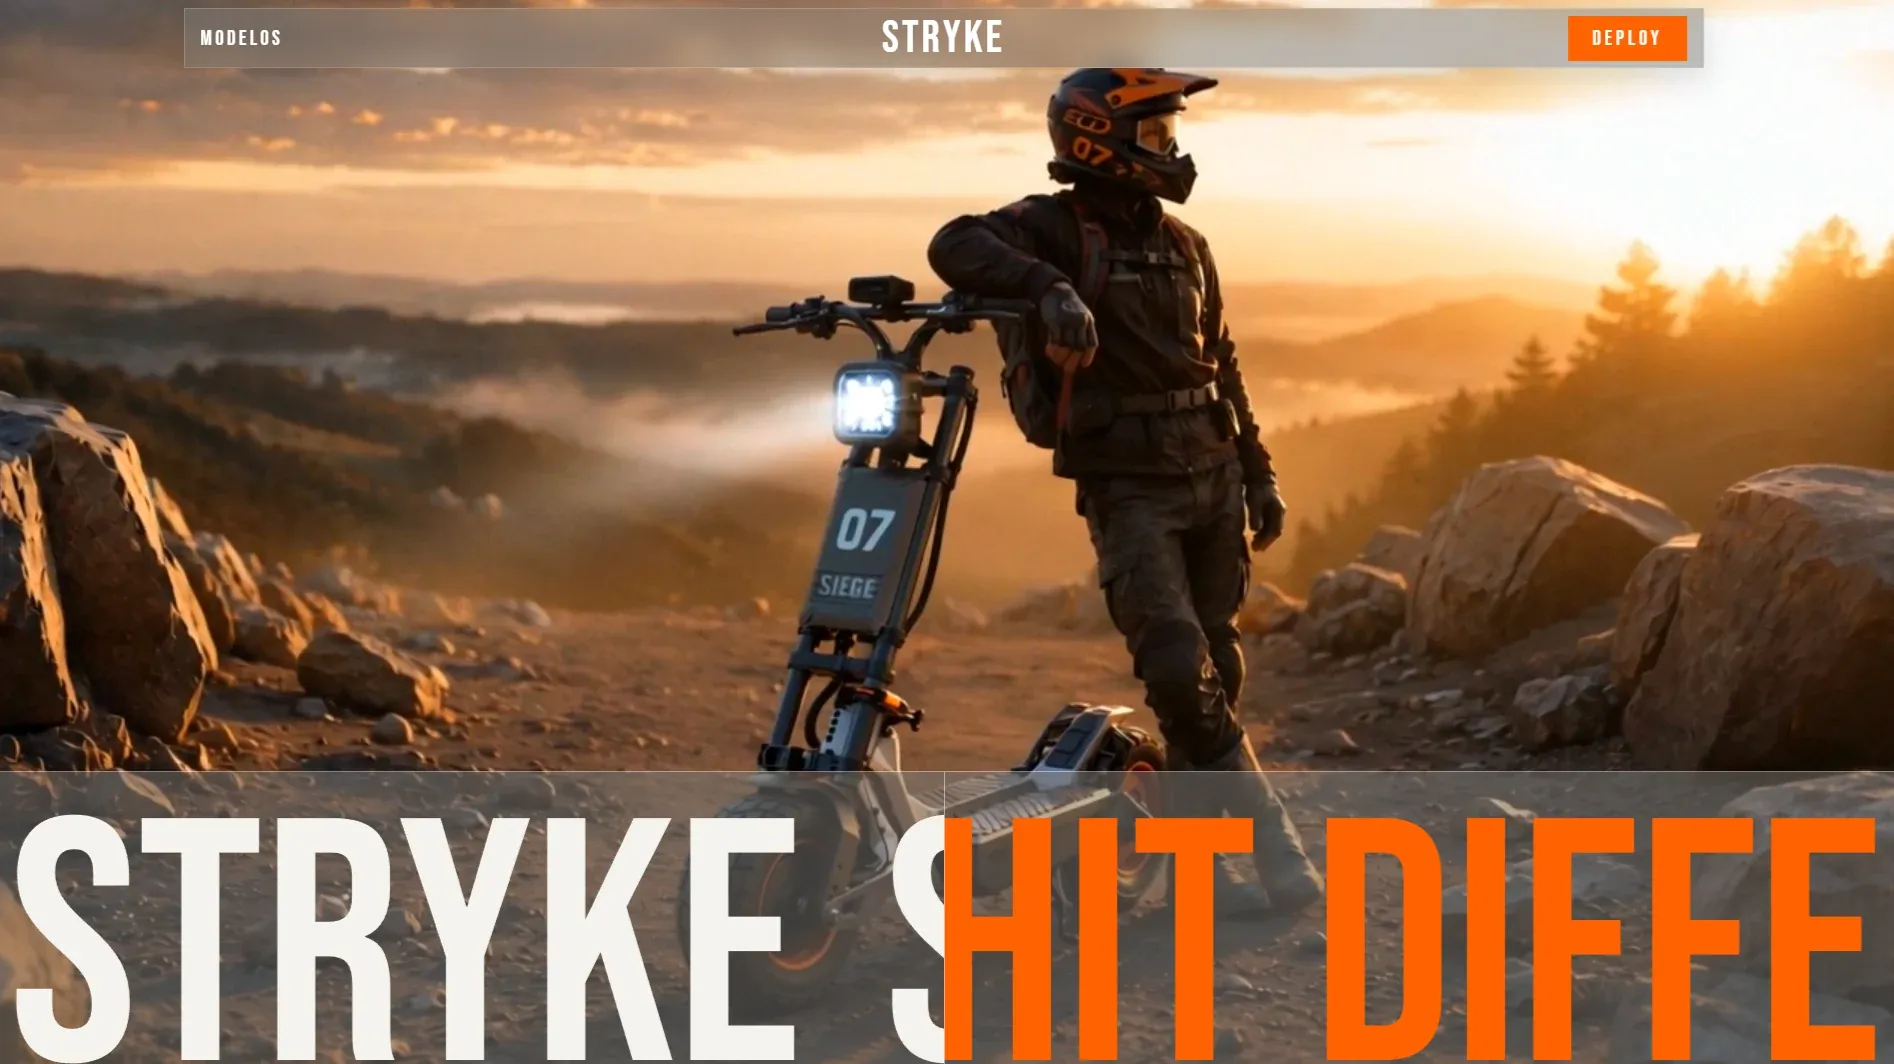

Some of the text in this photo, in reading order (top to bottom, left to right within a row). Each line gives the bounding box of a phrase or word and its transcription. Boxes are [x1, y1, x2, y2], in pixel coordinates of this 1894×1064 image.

[1073, 136, 1113, 165] 07
[836, 507, 896, 552] 07
[818, 574, 877, 599] SIEGE
